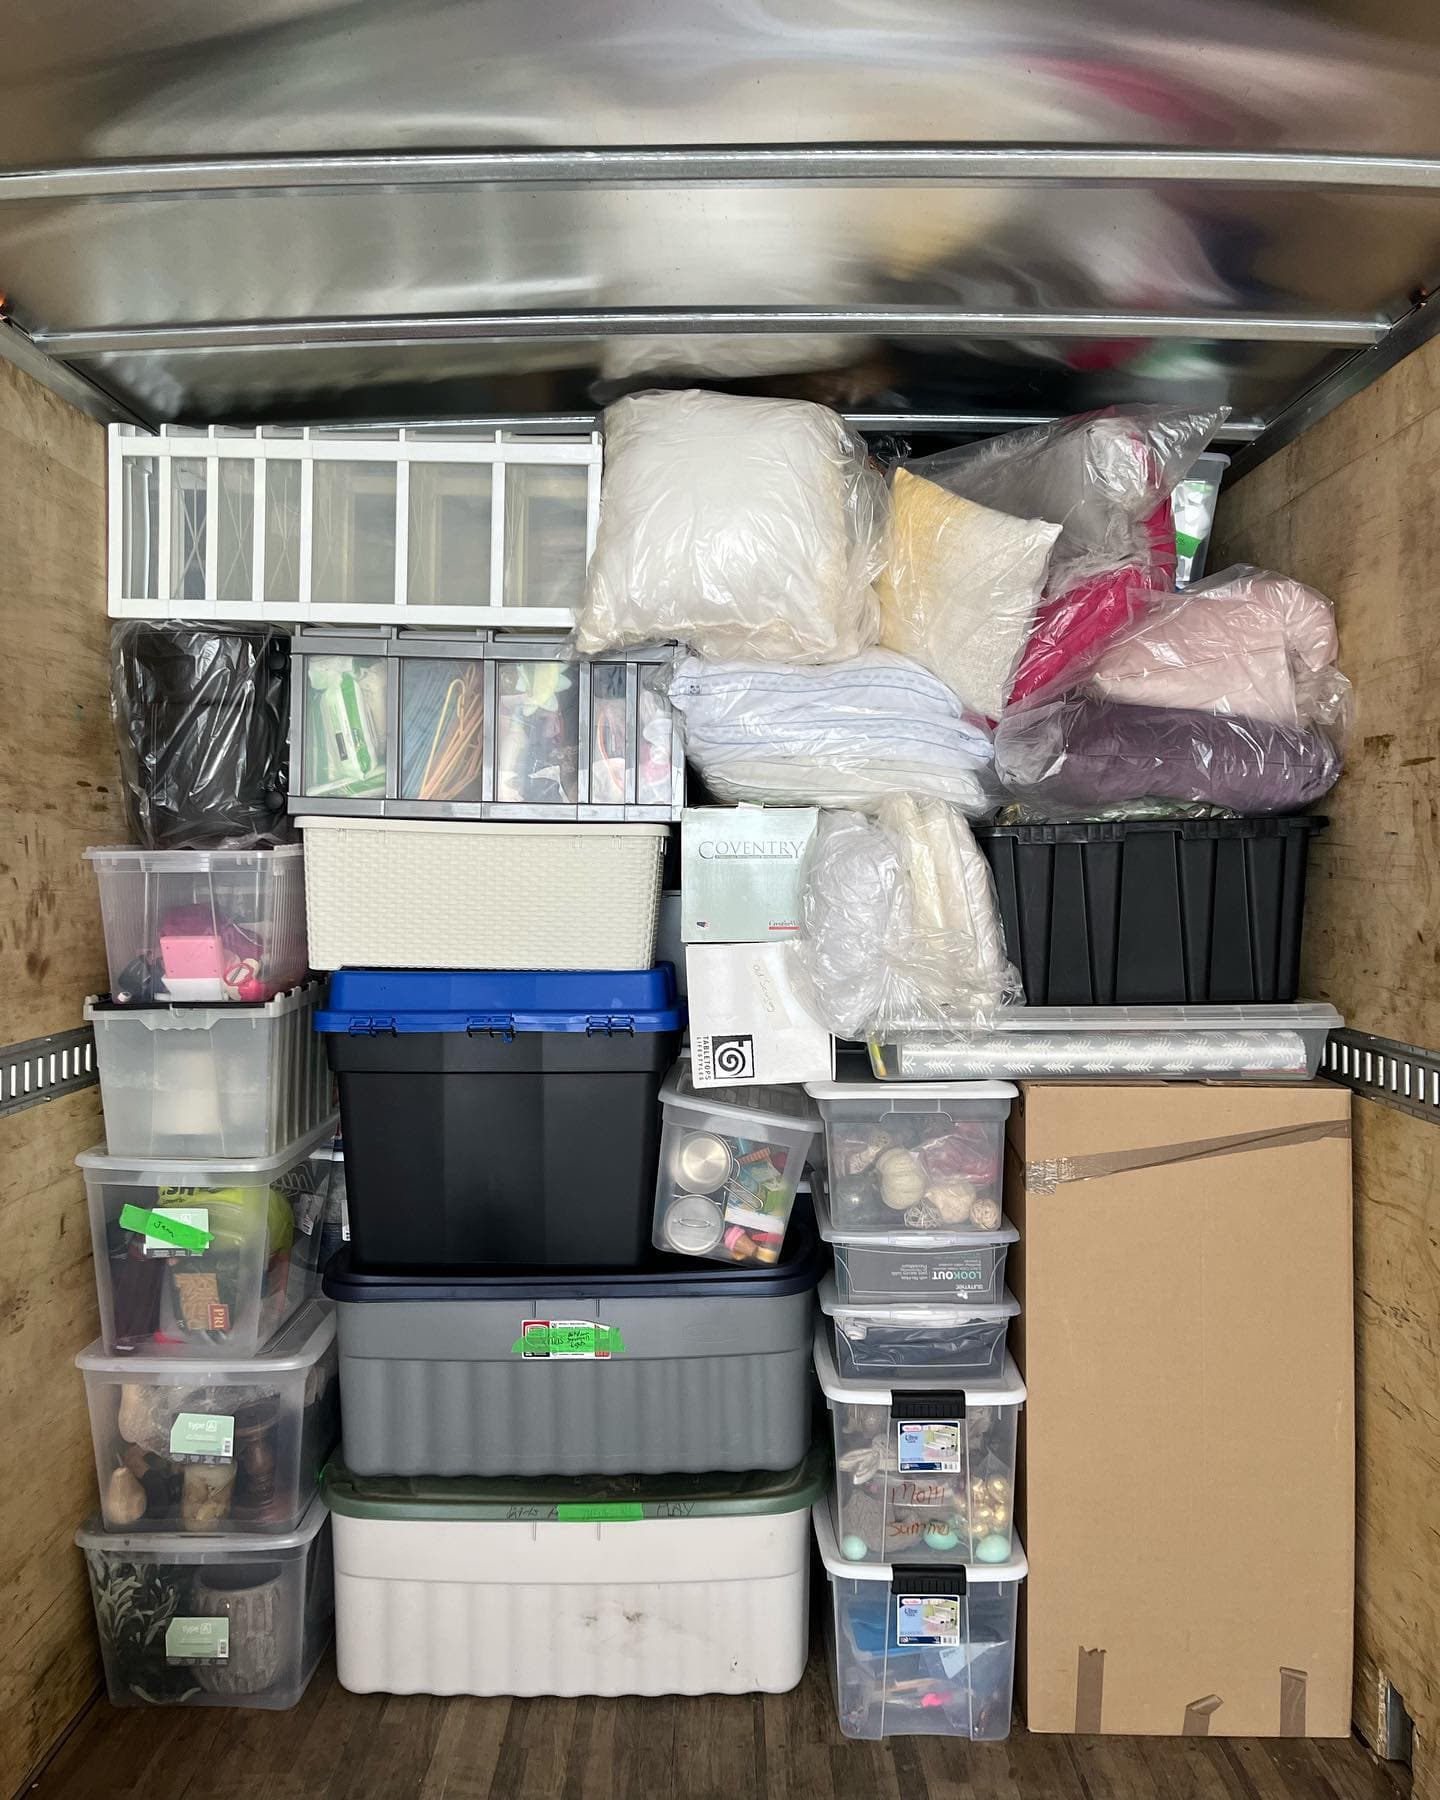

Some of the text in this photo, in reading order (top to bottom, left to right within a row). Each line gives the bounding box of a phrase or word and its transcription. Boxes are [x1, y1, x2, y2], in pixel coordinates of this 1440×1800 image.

[698, 840, 804, 859] COVENTRY
[696, 1036, 704, 1081] LIFESTYLES
[702, 1036, 712, 1081] TABLETOPS
[932, 1270, 983, 1280] LOOKOUT
